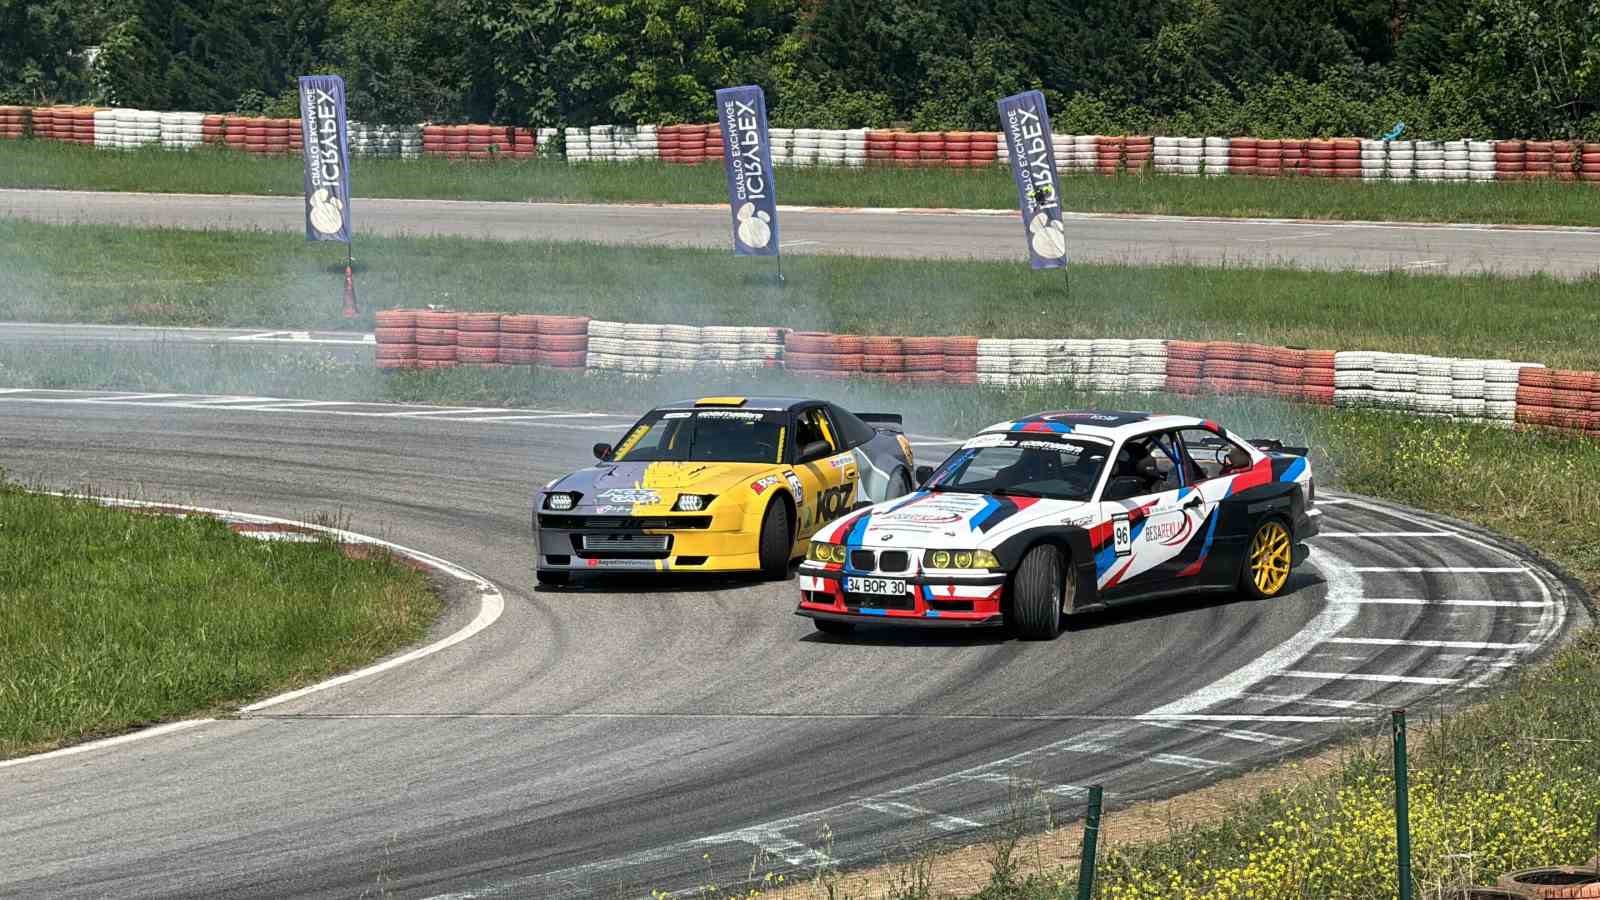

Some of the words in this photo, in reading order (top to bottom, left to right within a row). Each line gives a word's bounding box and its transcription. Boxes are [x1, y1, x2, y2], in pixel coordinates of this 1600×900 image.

[1116, 526, 1128, 545] 96
[848, 578, 861, 592] 34
[863, 579, 887, 593] BOR
[890, 581, 905, 594] 30
